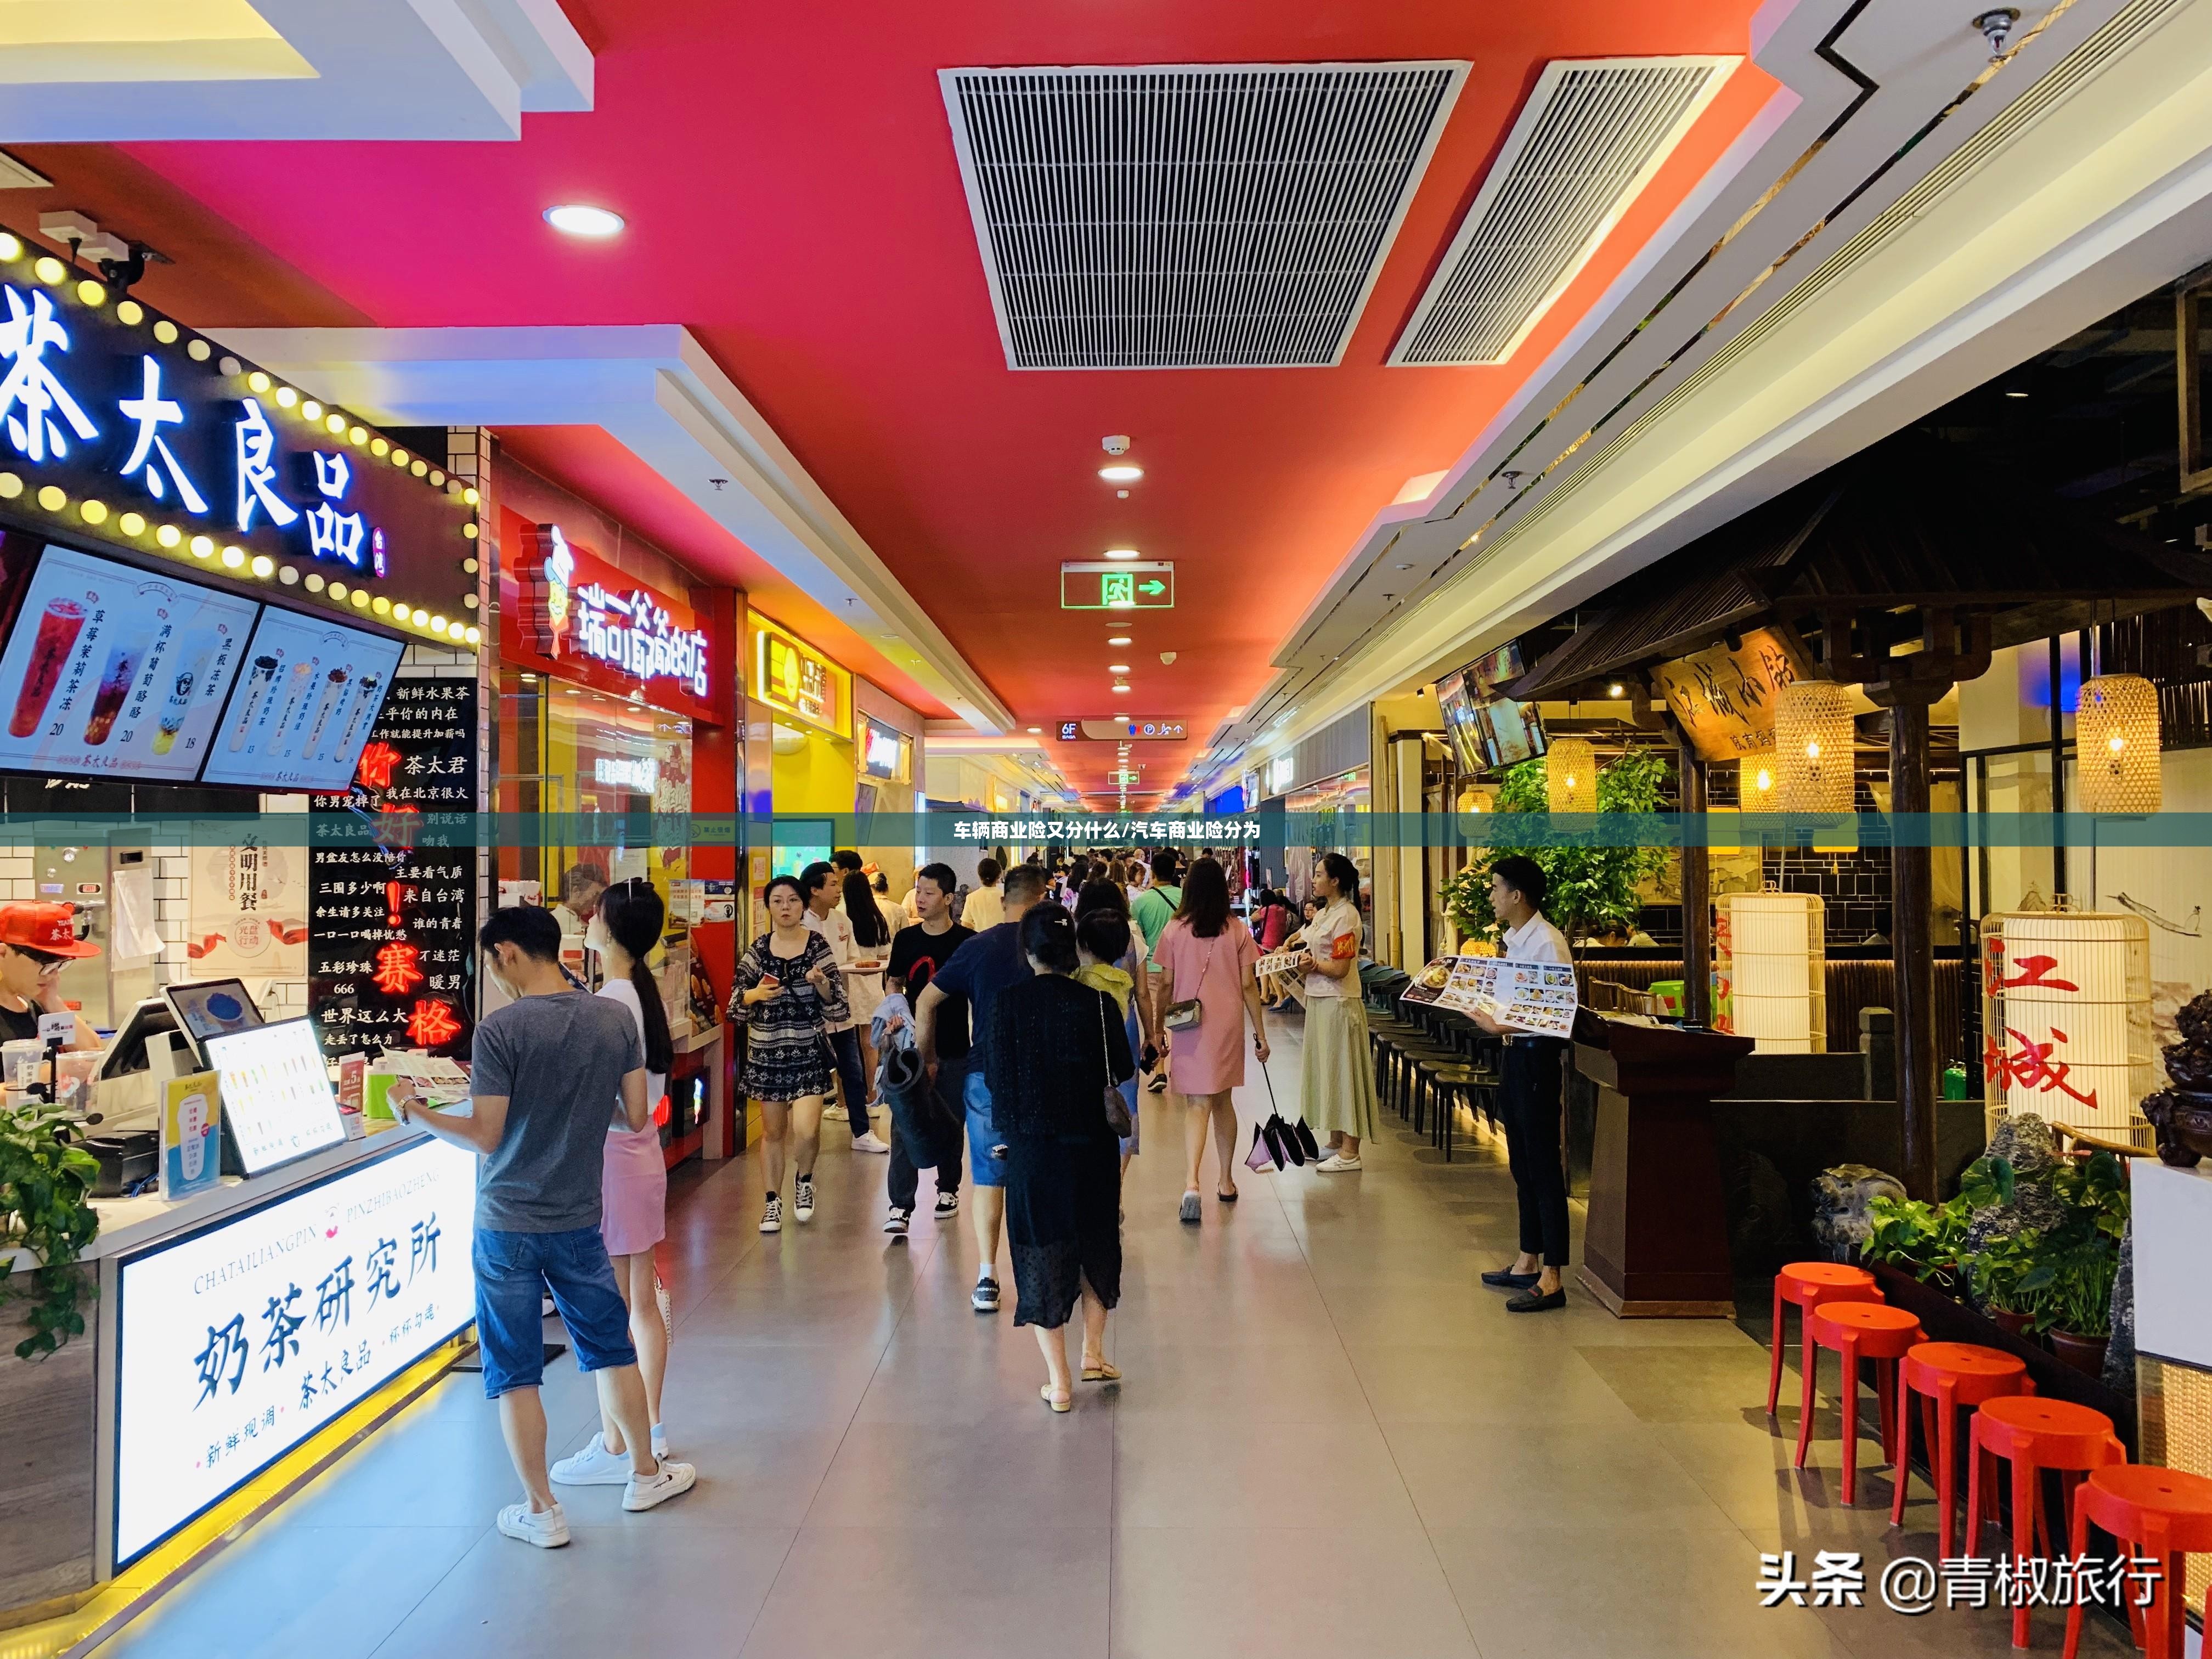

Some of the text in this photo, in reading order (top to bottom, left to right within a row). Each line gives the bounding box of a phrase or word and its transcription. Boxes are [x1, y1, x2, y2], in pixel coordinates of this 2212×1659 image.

[0, 284, 364, 565] 茶太良品
[49, 723, 64, 736] 20
[1062, 724, 1076, 735] 6F
[120, 730, 133, 743] 20
[185, 737, 196, 749] 18
[404, 755, 468, 776] 茶太君
[386, 787, 469, 800] 我在北京很火
[427, 813, 467, 825] 别说话
[316, 823, 369, 837] 茶太良品
[422, 835, 449, 847] 吻我
[239, 833, 258, 911] 文明用餐
[395, 866, 462, 879] 主要看气质
[319, 881, 386, 895] 三围多少啊
[403, 888, 465, 903] 来自台湾
[315, 906, 385, 918] 余生请多关注
[314, 928, 407, 941] 一口一口喝掉忧愁
[318, 961, 373, 974] 五彩珍珠
[430, 974, 461, 990] 暖男
[334, 984, 354, 994] 666
[321, 1007, 409, 1025] 世界这么大
[1984, 936, 2098, 1110] 江城
[192, 1211, 441, 1413] 奶茶研究所
[206, 1406, 275, 1468] 新鲜现调
[299, 1339, 371, 1412] 茶太良品
